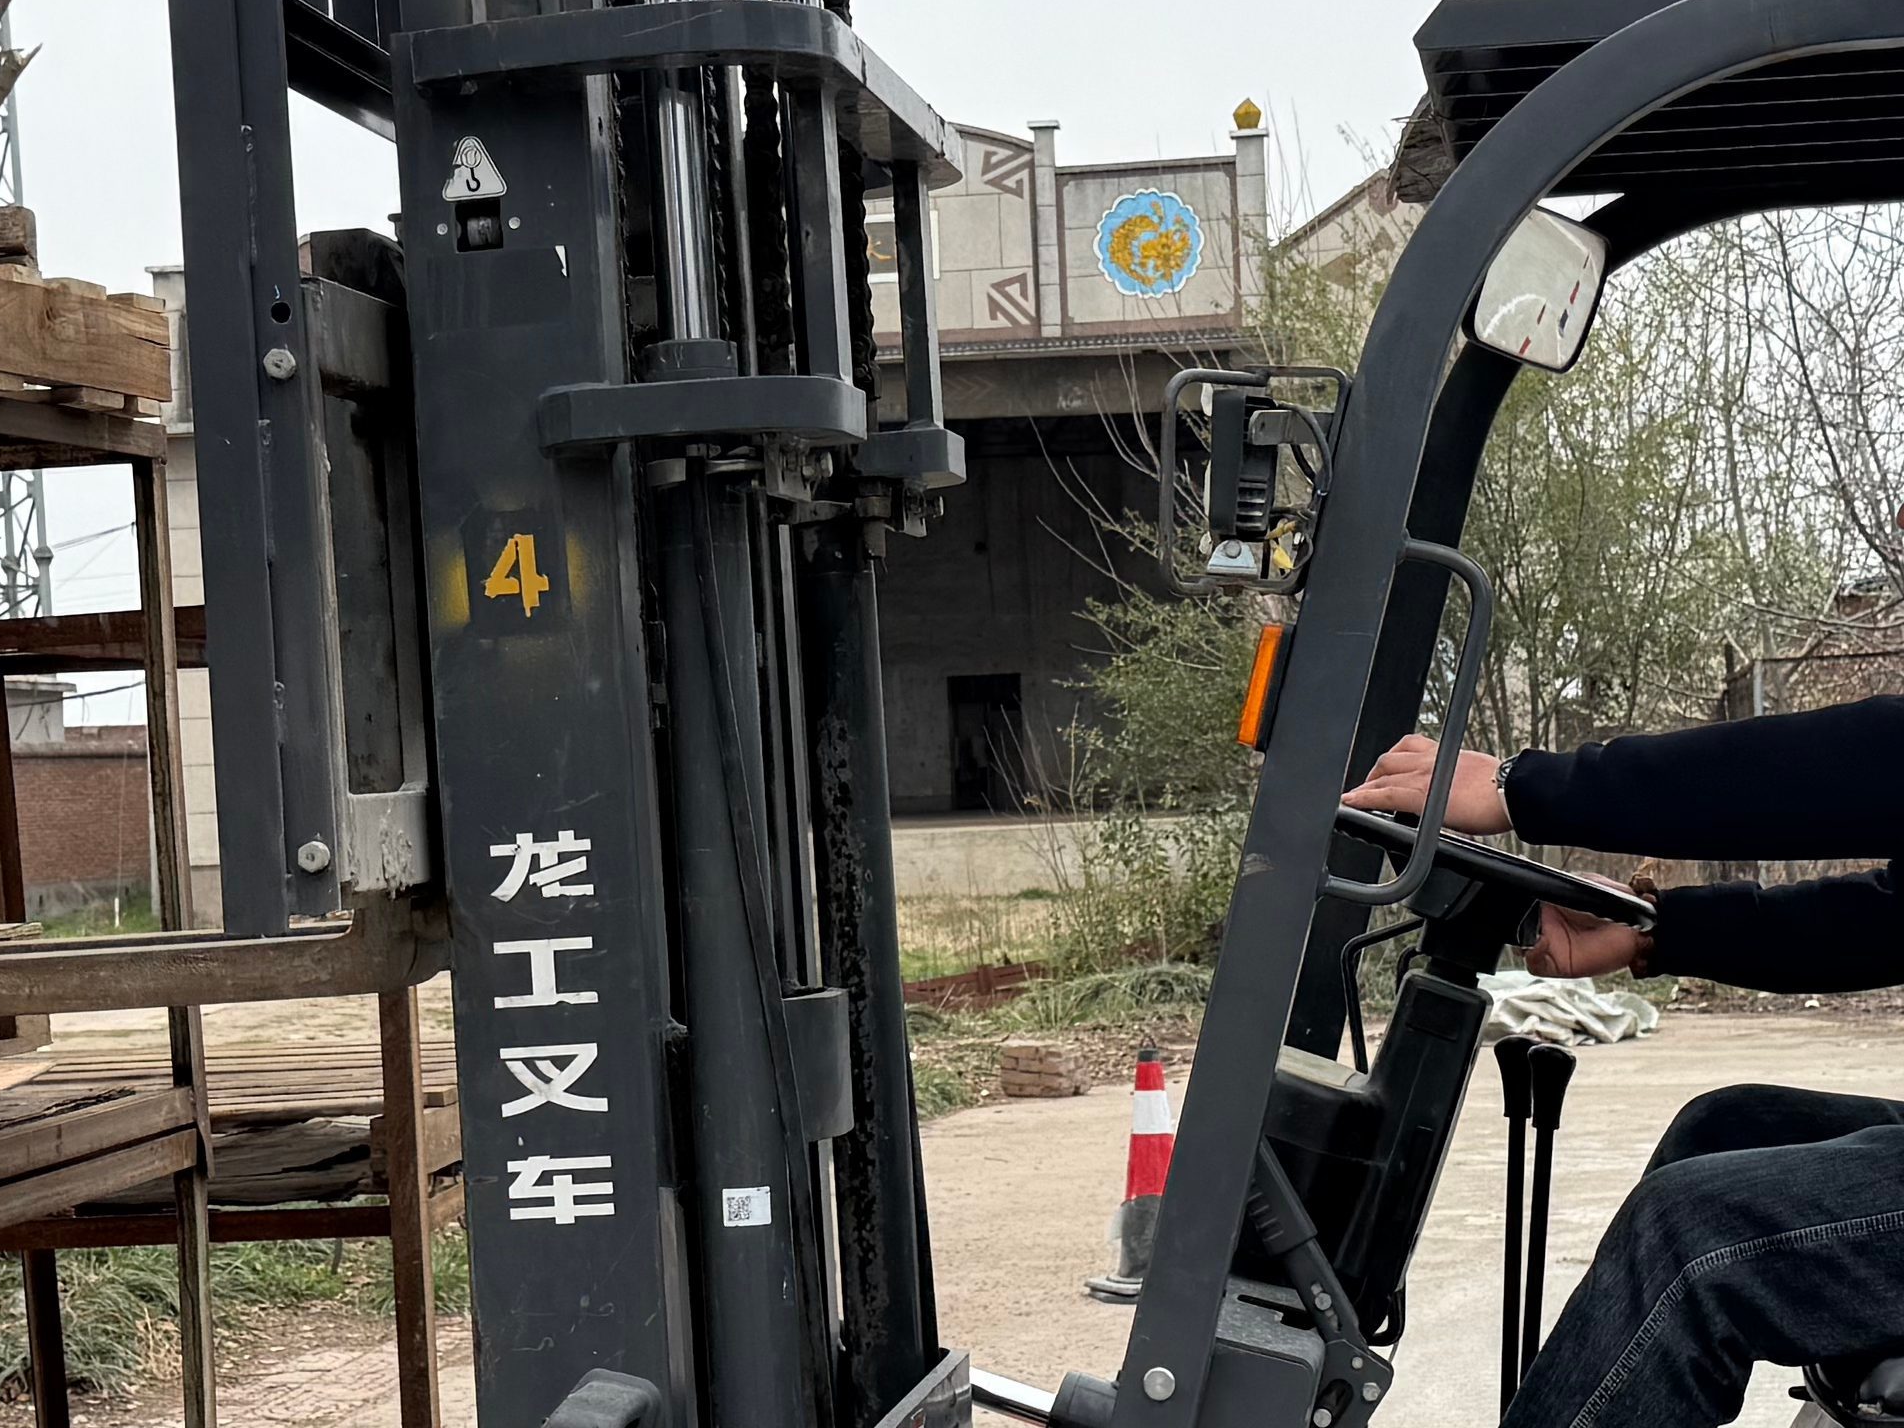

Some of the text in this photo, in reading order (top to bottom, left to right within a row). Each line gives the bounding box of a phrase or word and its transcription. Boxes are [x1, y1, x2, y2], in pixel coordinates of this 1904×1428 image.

[483, 532, 550, 617] 4
[489, 828, 616, 1225] 龙工叉车
